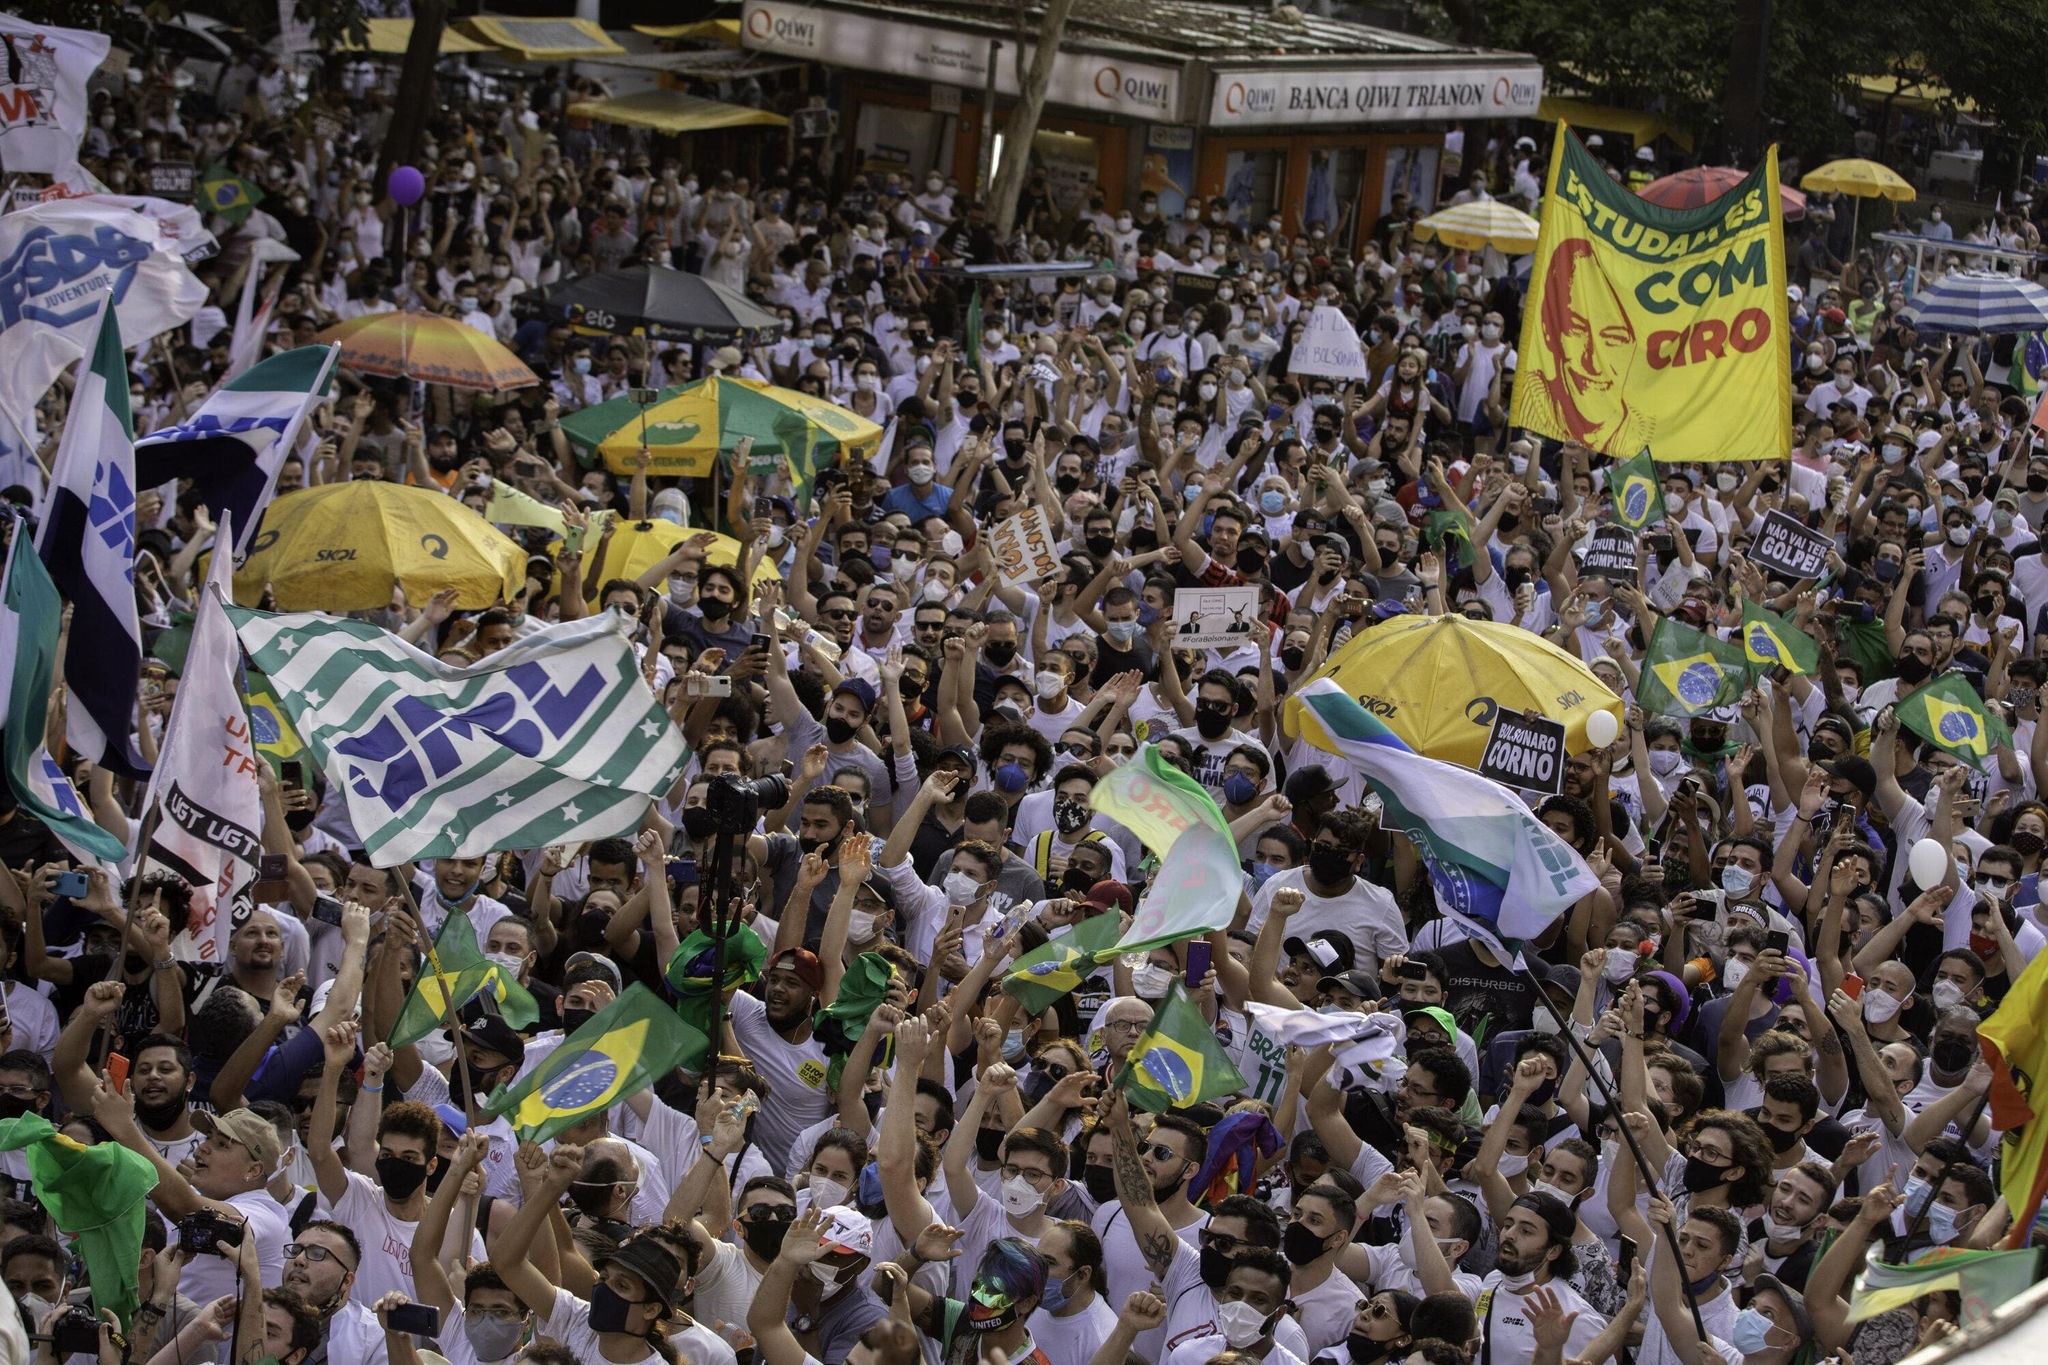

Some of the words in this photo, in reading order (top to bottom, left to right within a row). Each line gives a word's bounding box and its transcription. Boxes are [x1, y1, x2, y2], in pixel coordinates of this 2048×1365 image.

[1288, 86, 1349, 111] BANCA
[1355, 85, 1403, 113] QIWI
[1406, 83, 1486, 107] TRIANON
[1566, 167, 1765, 259] ESTUDANES
[0, 226, 150, 328] PSDB
[44, 274, 113, 309] JUVENTUDE
[1634, 238, 1768, 315] COM
[1646, 307, 1772, 371] CIRO
[314, 548, 358, 562] SKOL
[994, 519, 1029, 580] FORA
[1589, 538, 1616, 552] THUR
[1617, 540, 1636, 555] LIRA
[1761, 536, 1822, 574] GOLPE!
[1766, 521, 1789, 541] NÃO
[1788, 531, 1808, 549] VAI
[1806, 538, 1828, 560] TER
[1587, 551, 1633, 569] CÚMPLICE
[1182, 635, 1239, 643] #ForaBolsonaro
[1358, 694, 1400, 719] SKOL
[1556, 689, 1586, 711] SKOL
[1497, 722, 1557, 753] BOLSONARO
[1487, 740, 1555, 782] CORNO
[171, 791, 206, 829] UGT
[207, 819, 258, 857] UGT
[1449, 976, 1526, 993] DISTURBED
[803, 1062, 825, 1079] 12/09
[1253, 1063, 1285, 1105] 11
